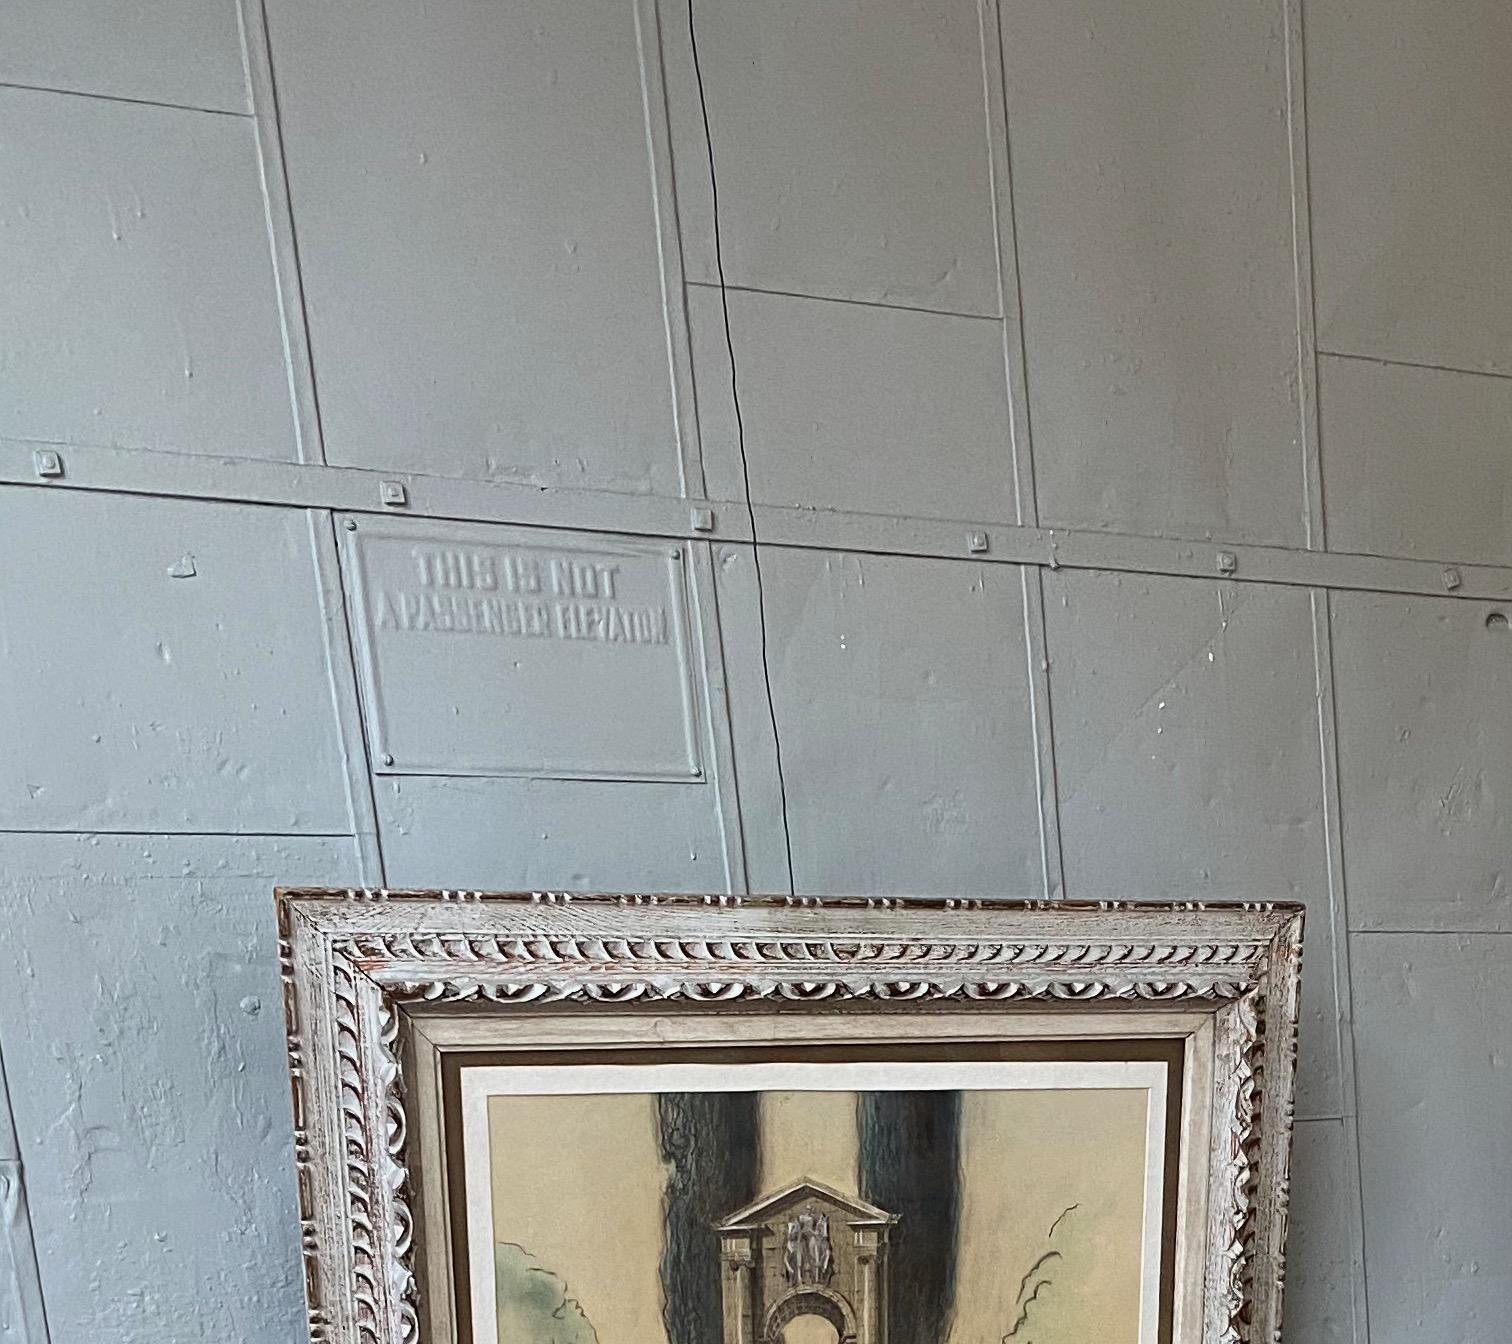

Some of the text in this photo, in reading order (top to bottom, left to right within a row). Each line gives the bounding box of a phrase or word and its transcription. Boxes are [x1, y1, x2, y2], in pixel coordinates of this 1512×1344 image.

[411, 550, 621, 600] THIS IS NOT
[374, 591, 670, 645] A PASSENGER ELEVATOR
